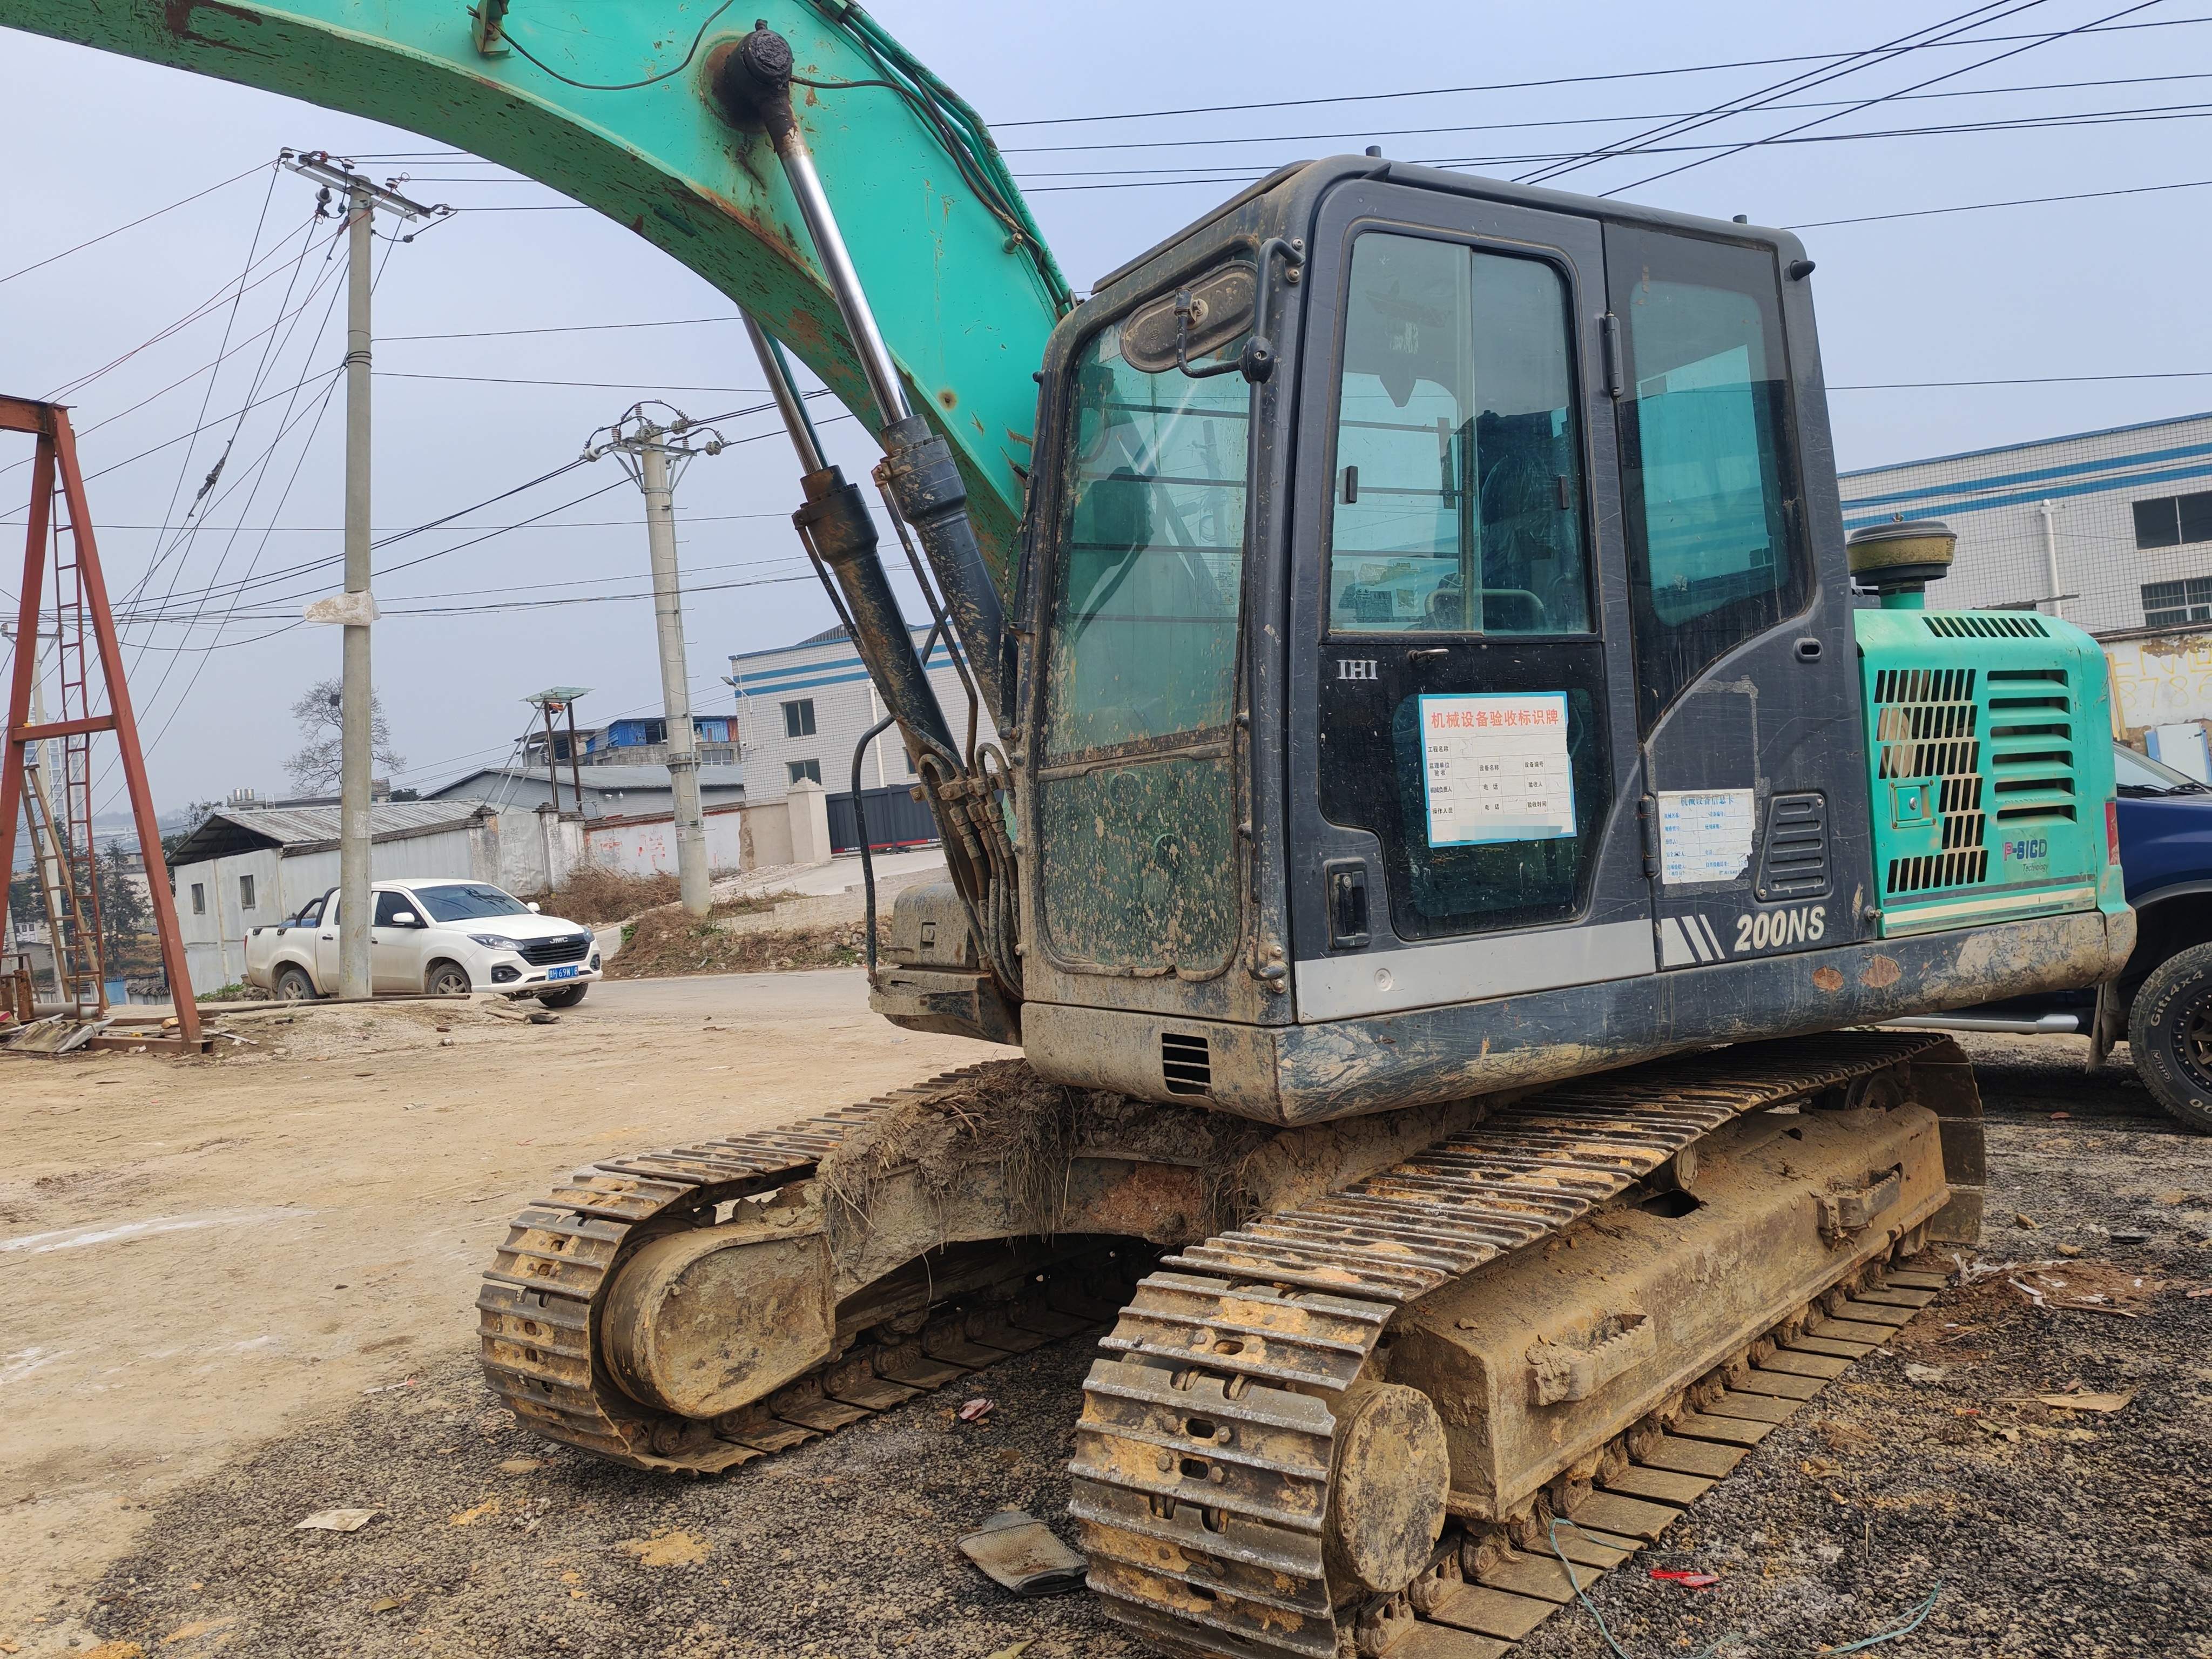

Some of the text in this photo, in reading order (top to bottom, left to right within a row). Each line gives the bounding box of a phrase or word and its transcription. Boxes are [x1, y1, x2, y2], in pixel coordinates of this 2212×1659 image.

[1336, 660, 1378, 679] IHI
[1431, 709, 1559, 729] 机械设备验收标识牌
[1734, 905, 1826, 952] 200NS
